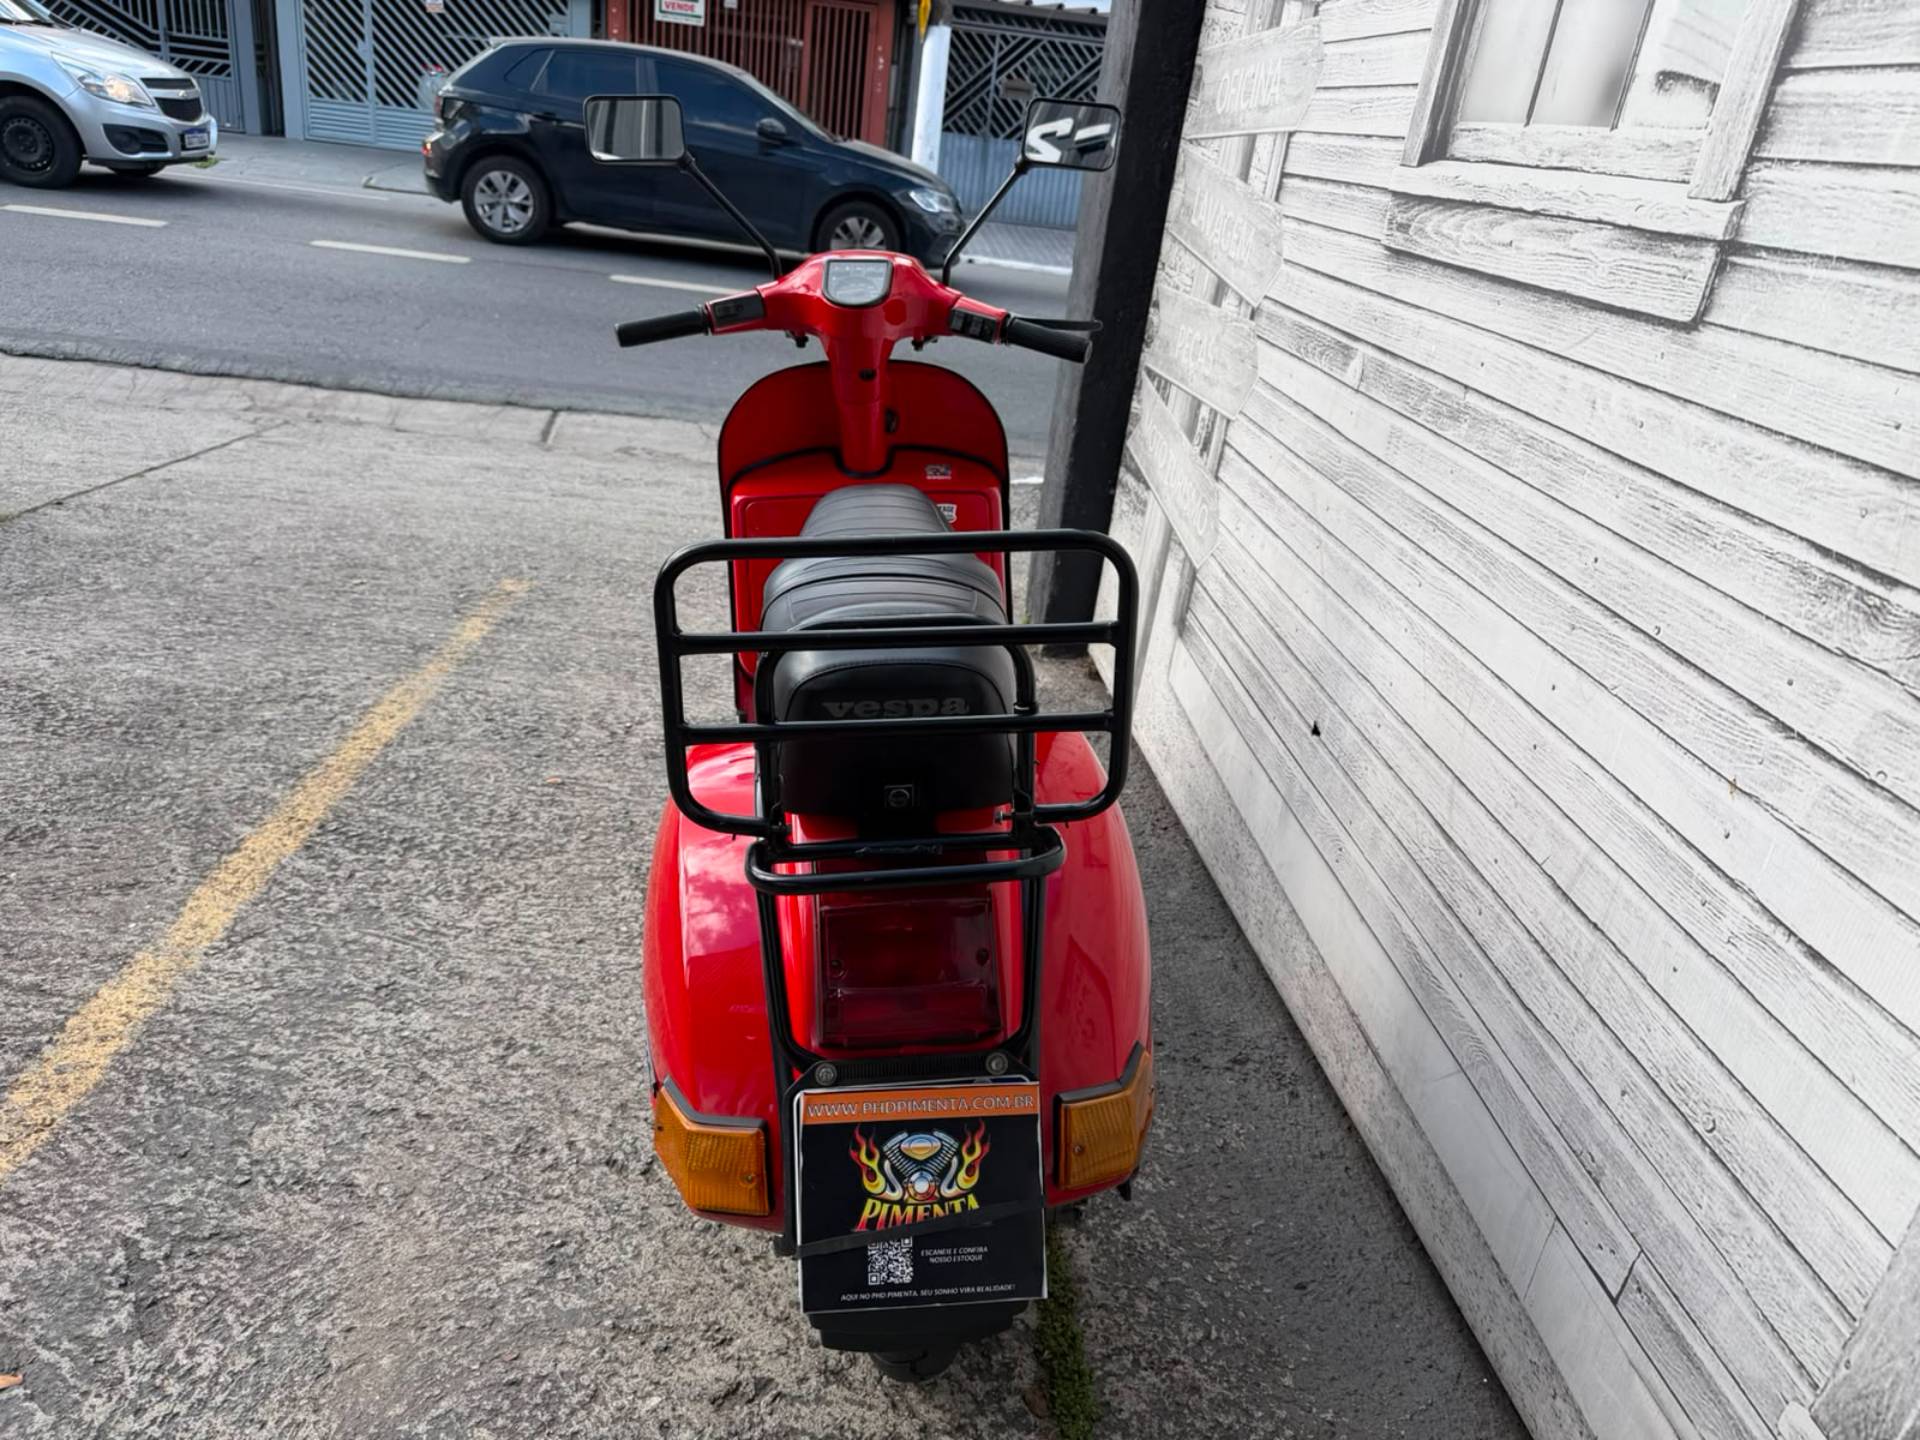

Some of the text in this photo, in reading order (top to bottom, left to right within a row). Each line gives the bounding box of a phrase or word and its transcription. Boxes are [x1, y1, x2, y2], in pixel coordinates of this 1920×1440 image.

[664, 1, 695, 12] VENDE
[1216, 57, 1282, 114] OFICINA
[1191, 187, 1256, 263] LAVAGEM
[821, 697, 970, 718] vespa
[854, 1193, 980, 1232] PIMENTA
[929, 1255, 952, 1263] NOSSO
[840, 1293, 858, 1301] AQUI
[859, 1292, 871, 1300] NO
[920, 1288, 934, 1296] SEU
[934, 1287, 959, 1295] SONHO
[959, 1286, 976, 1294] VIRA
